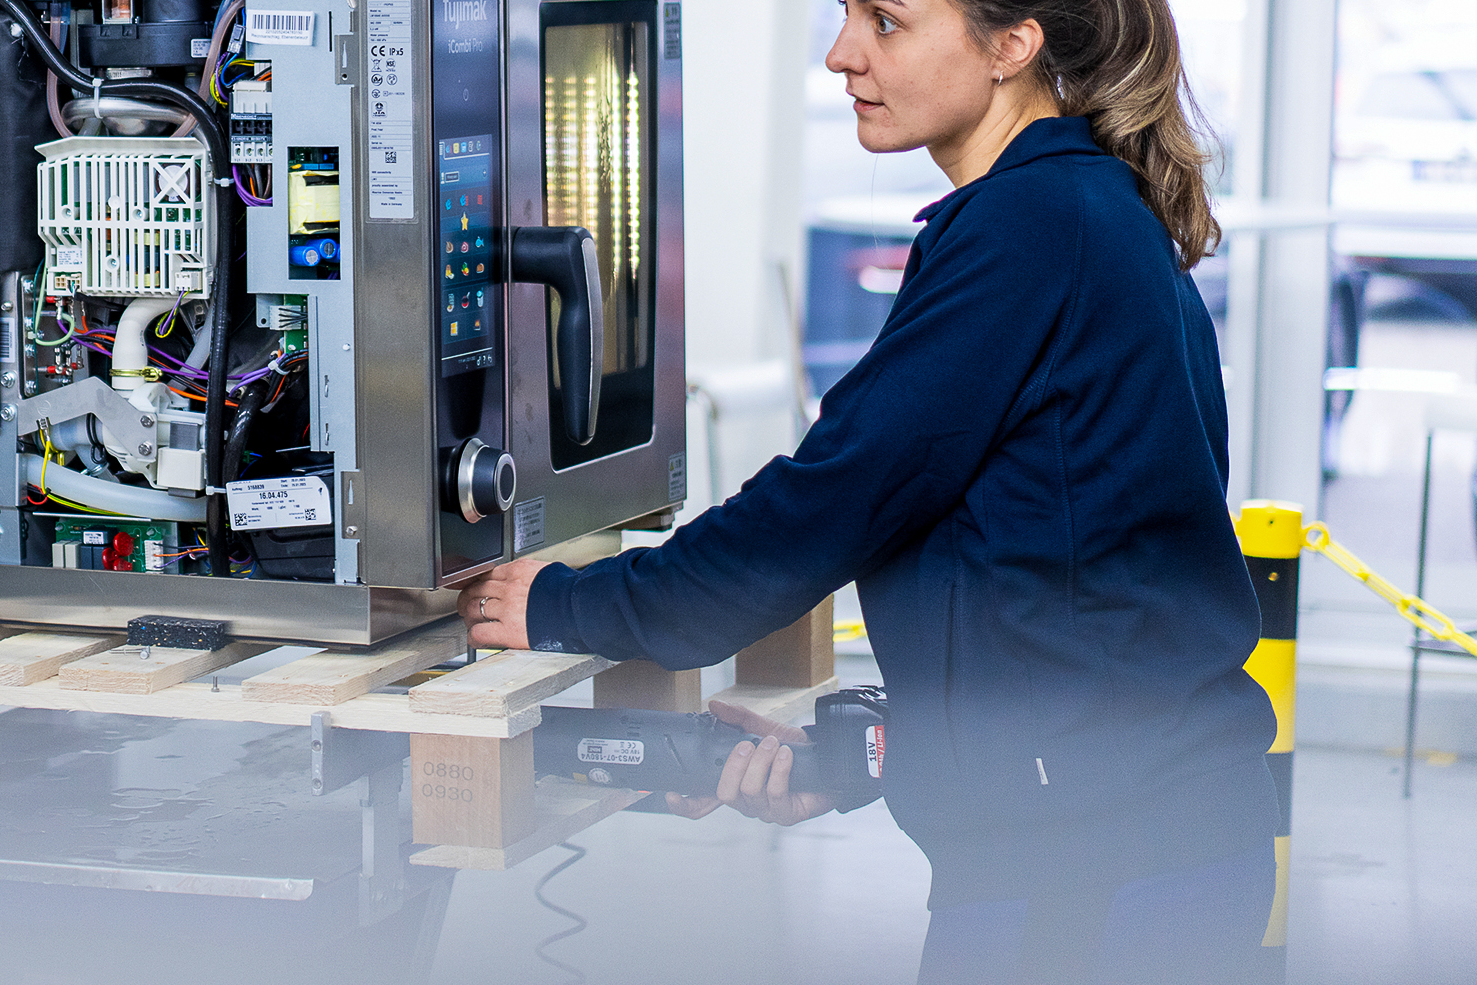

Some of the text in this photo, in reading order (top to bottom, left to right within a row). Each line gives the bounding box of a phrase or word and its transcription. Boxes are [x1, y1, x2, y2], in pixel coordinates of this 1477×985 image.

[370, 45, 386, 57] CE
[448, 37, 483, 54] iCombi Pro
[259, 491, 288, 500] 16.04.475
[868, 741, 877, 762] 18V
[423, 761, 474, 781] 0880
[422, 783, 473, 803] 0930
